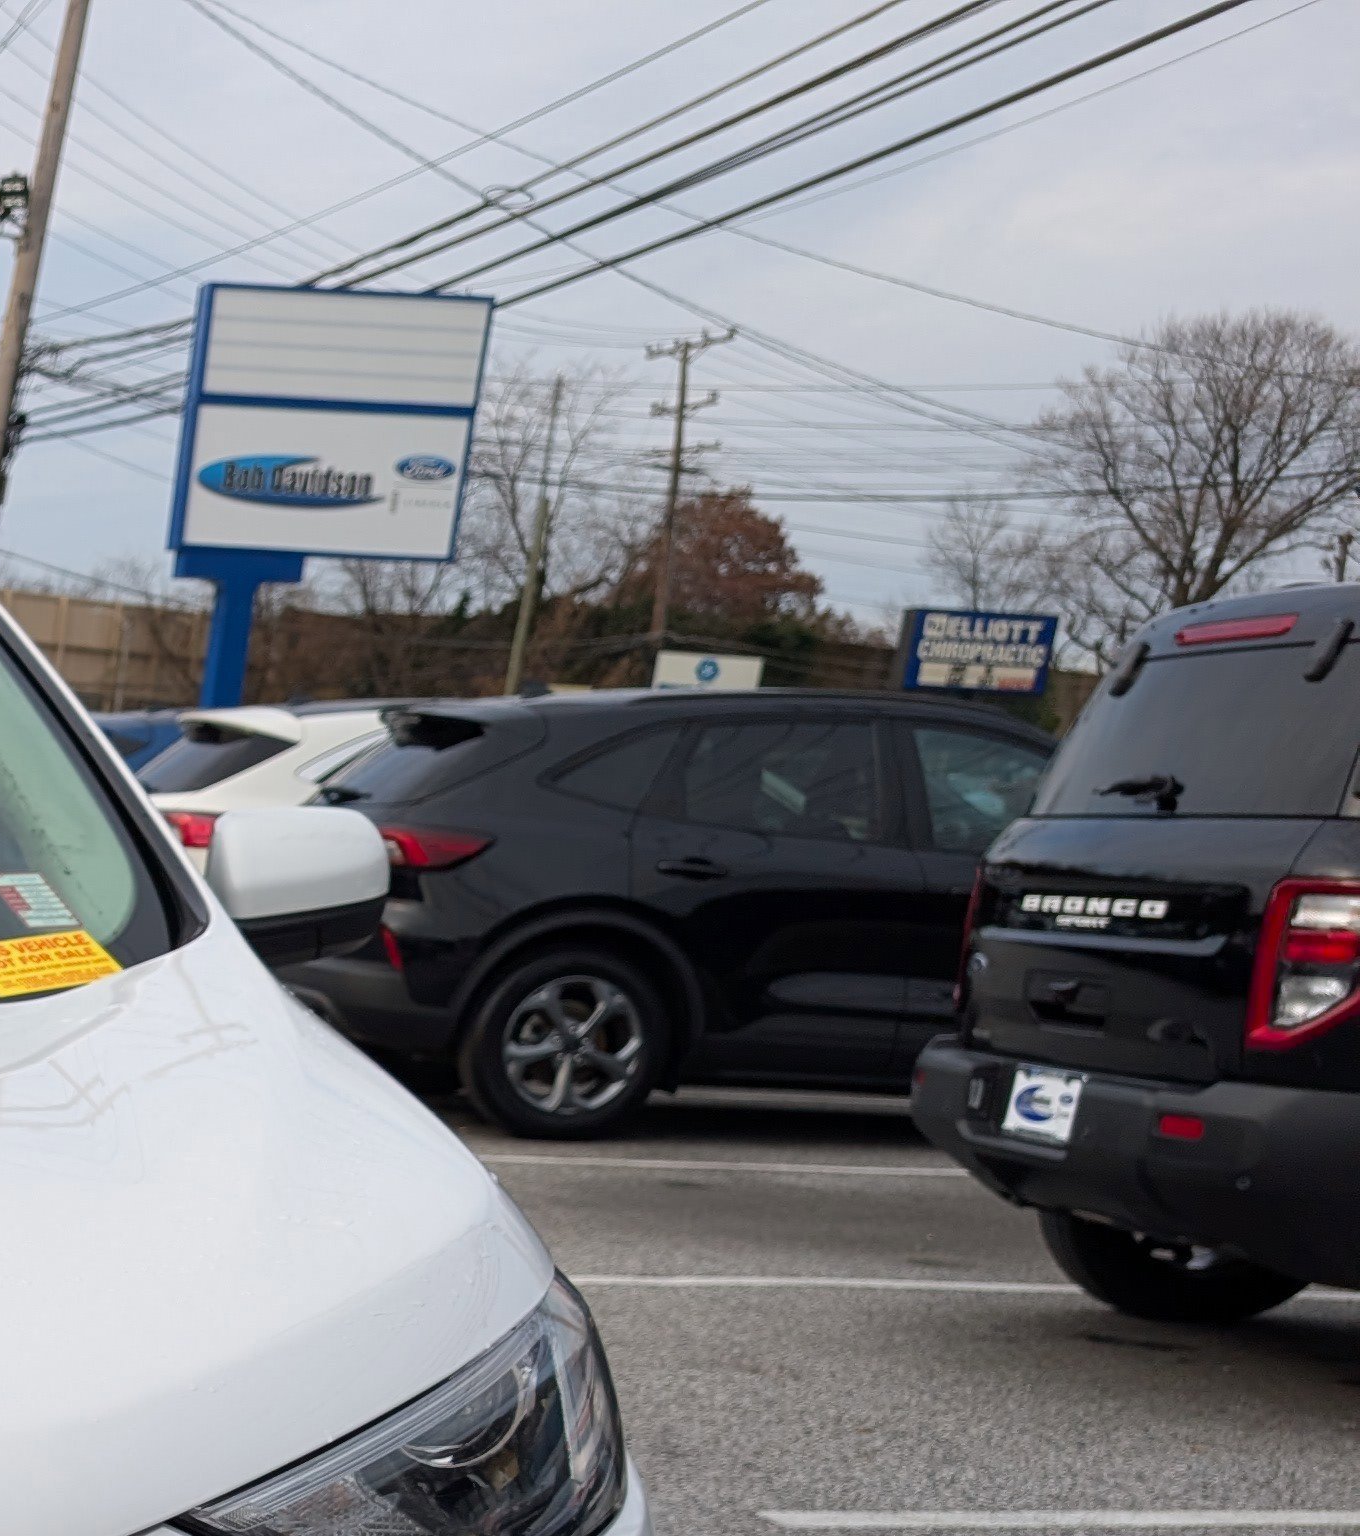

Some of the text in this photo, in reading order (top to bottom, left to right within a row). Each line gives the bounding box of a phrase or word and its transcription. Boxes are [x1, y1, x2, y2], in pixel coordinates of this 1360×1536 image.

[223, 461, 373, 498] Bob Davidson
[1021, 894, 1169, 919] BRONCO
[10, 933, 90, 954] VEHICLE
[18, 952, 53, 965] FOR
[54, 947, 96, 960] SALE
